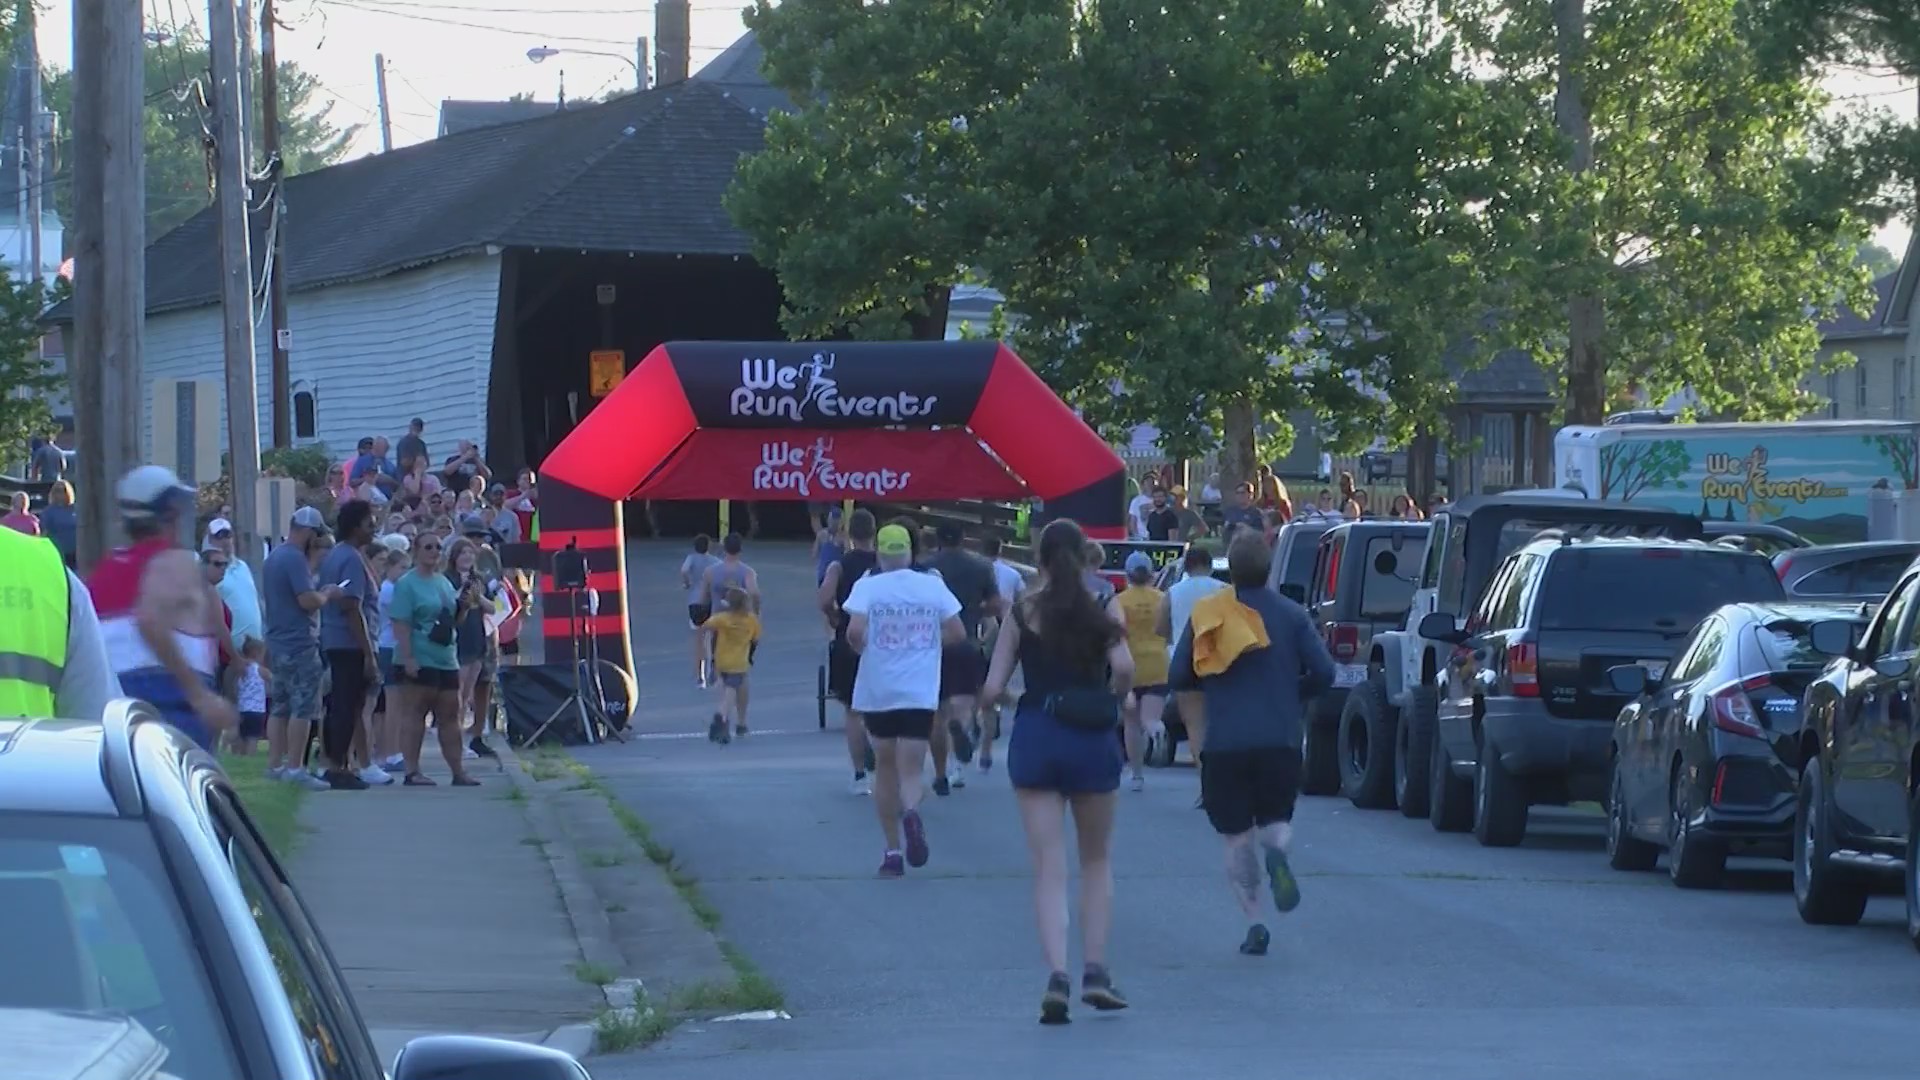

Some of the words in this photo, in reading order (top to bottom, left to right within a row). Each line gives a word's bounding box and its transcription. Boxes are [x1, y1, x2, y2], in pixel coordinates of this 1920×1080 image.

[742, 358, 798, 389] We
[730, 387, 803, 421] Run
[817, 388, 938, 421] Events
[762, 441, 804, 466] We
[1707, 453, 1742, 475] We
[754, 464, 810, 496] Run
[818, 464, 911, 496] Events
[1702, 476, 1748, 505] Run
